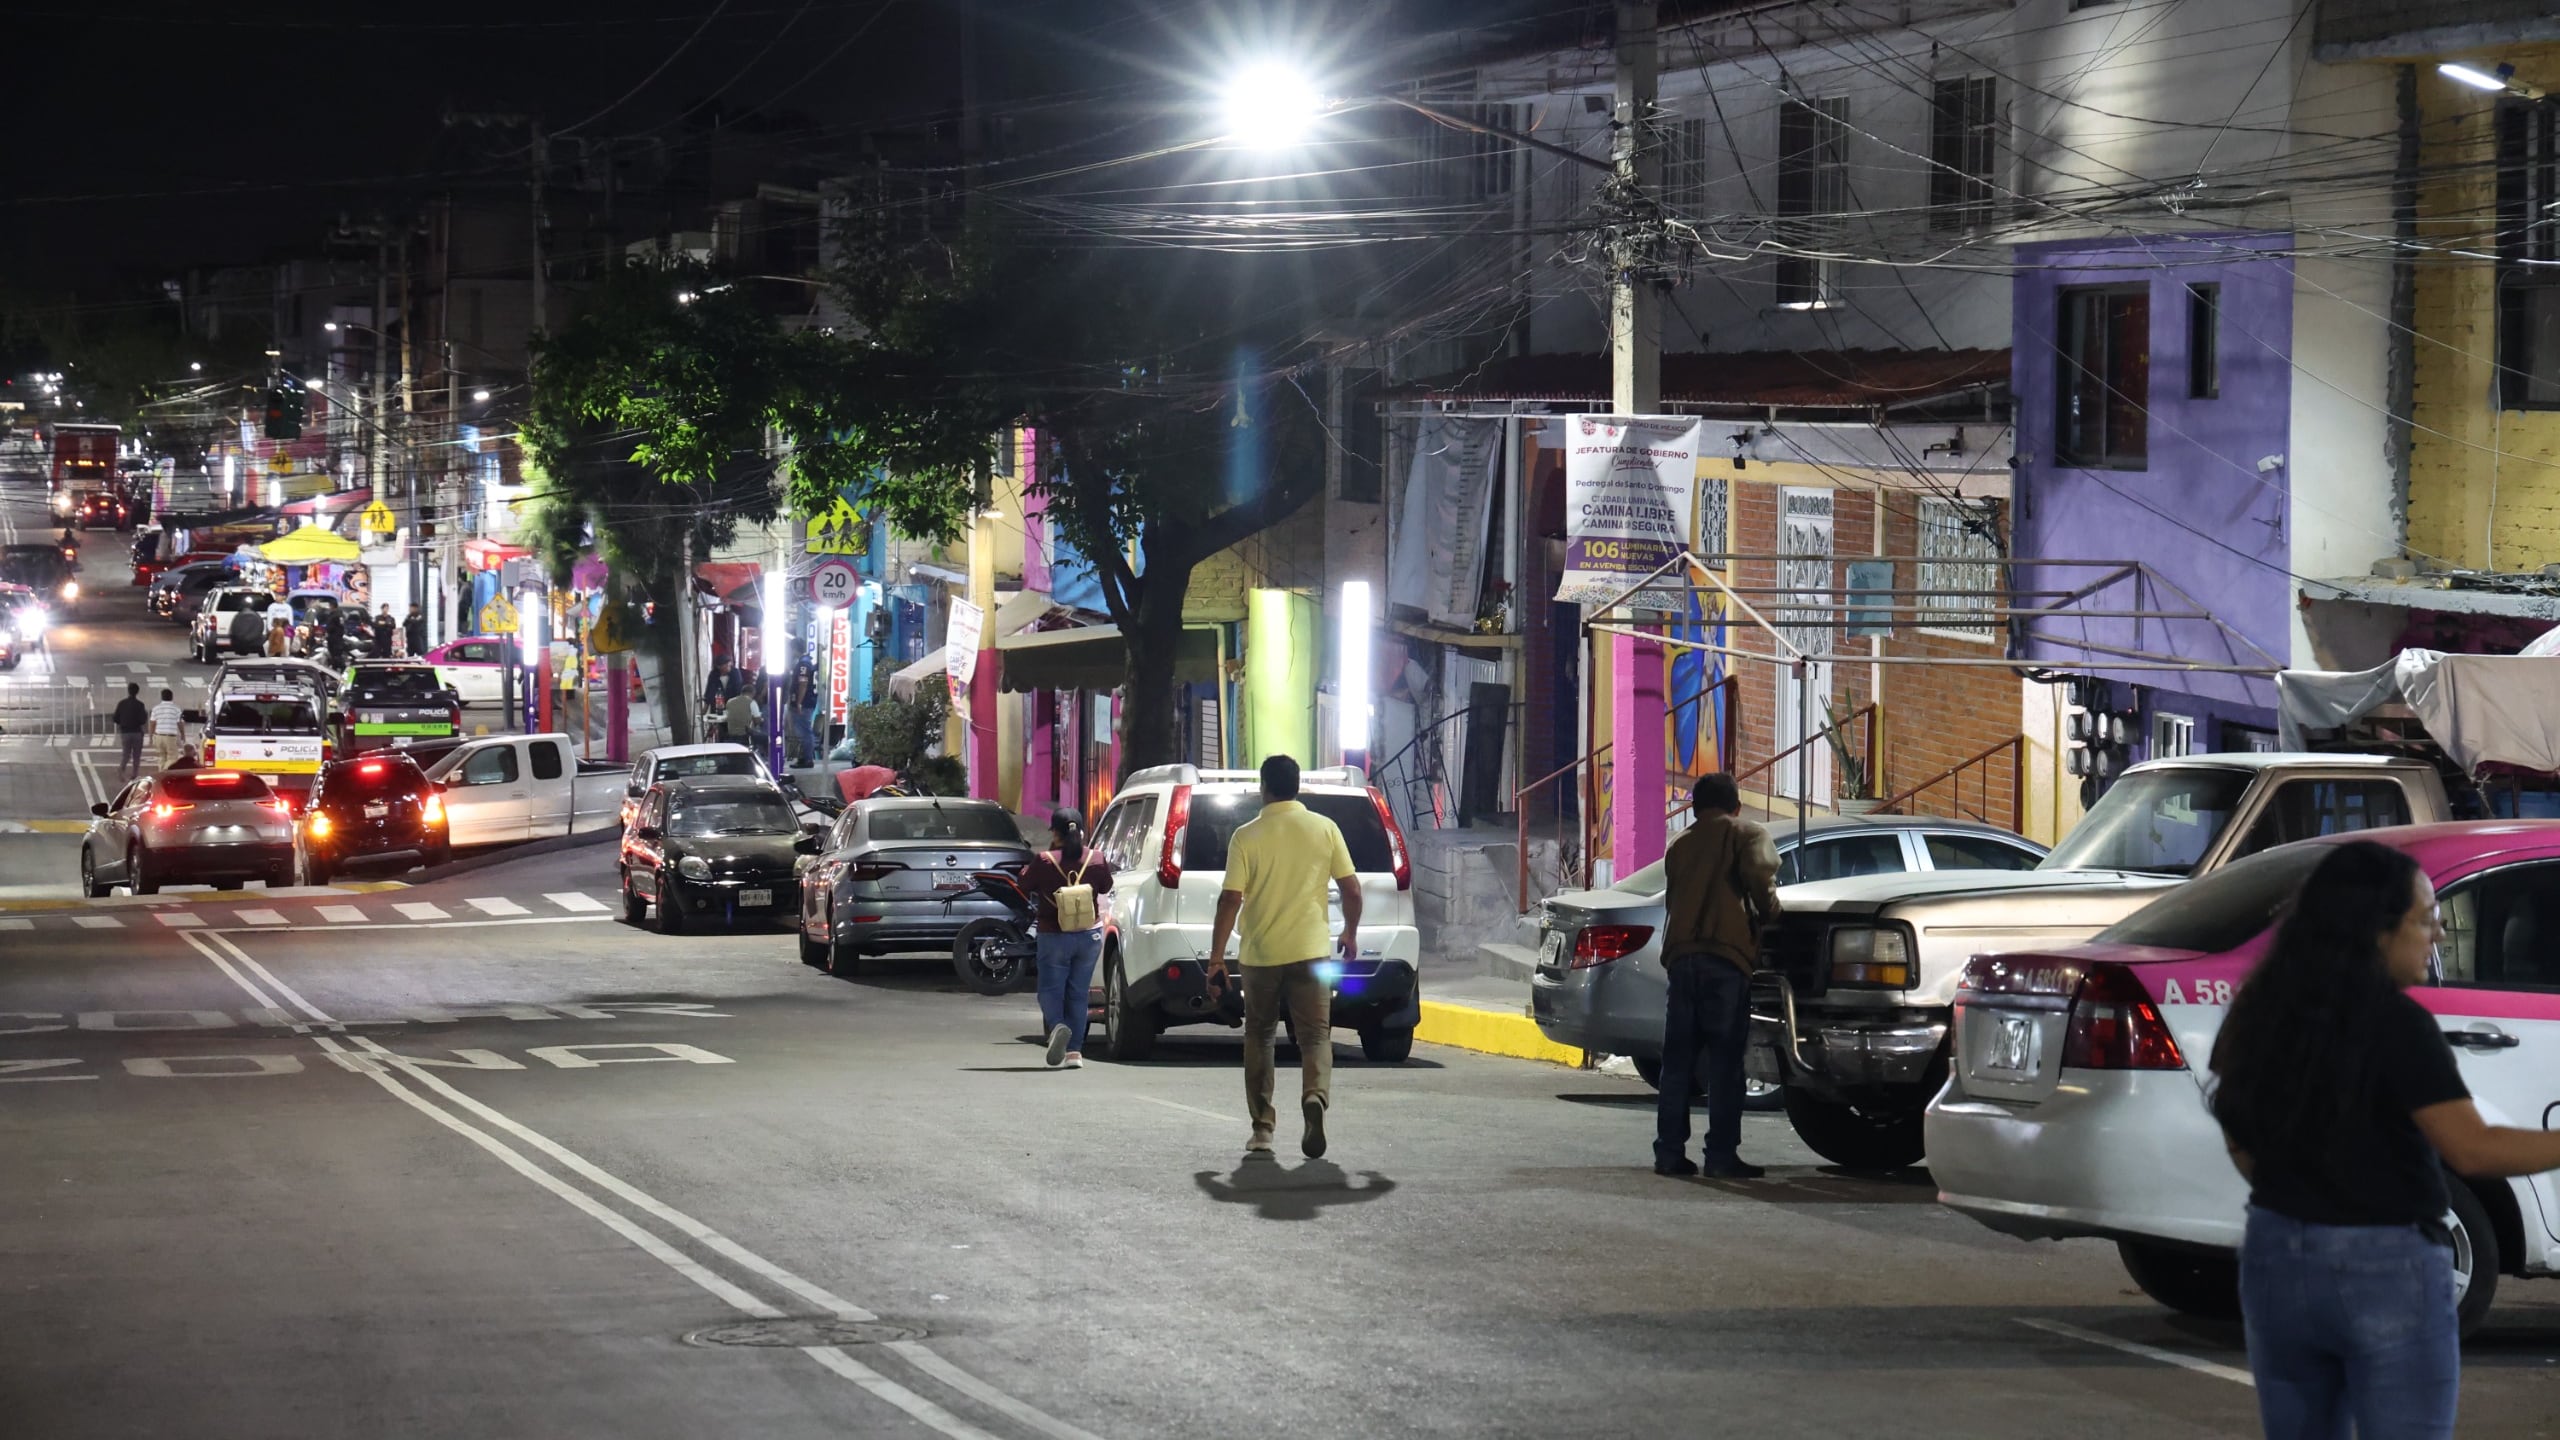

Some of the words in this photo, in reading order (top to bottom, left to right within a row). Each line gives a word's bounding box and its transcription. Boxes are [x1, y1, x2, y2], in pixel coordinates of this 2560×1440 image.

[1651, 422, 1660, 430] DE
[1575, 446, 1625, 455] JEFATURA
[1625, 446, 1638, 455] DE
[1639, 447, 1689, 460] GOBIERNO
[1576, 479, 1613, 490] Pedregal
[1624, 480, 1646, 489] Santo
[1648, 481, 1684, 494] Domingo
[1582, 503, 1633, 518] CAMINA
[1636, 507, 1675, 522] LIBRE
[1582, 518, 1624, 530] CAMINA
[1631, 520, 1676, 535] SEGURA
[1583, 540, 1619, 559] 106
[1620, 541, 1674, 553] LUMINARIAS
[1620, 551, 1655, 561] NUEVAS
[1579, 561, 1591, 569] EN
[1592, 561, 1626, 570] AVENIDA
[823, 572, 846, 587] 20
[822, 590, 846, 599] km/h
[280, 744, 319, 753] POLICÍA
[2164, 978, 2187, 1005] A
[2195, 979, 2236, 1005] 58
